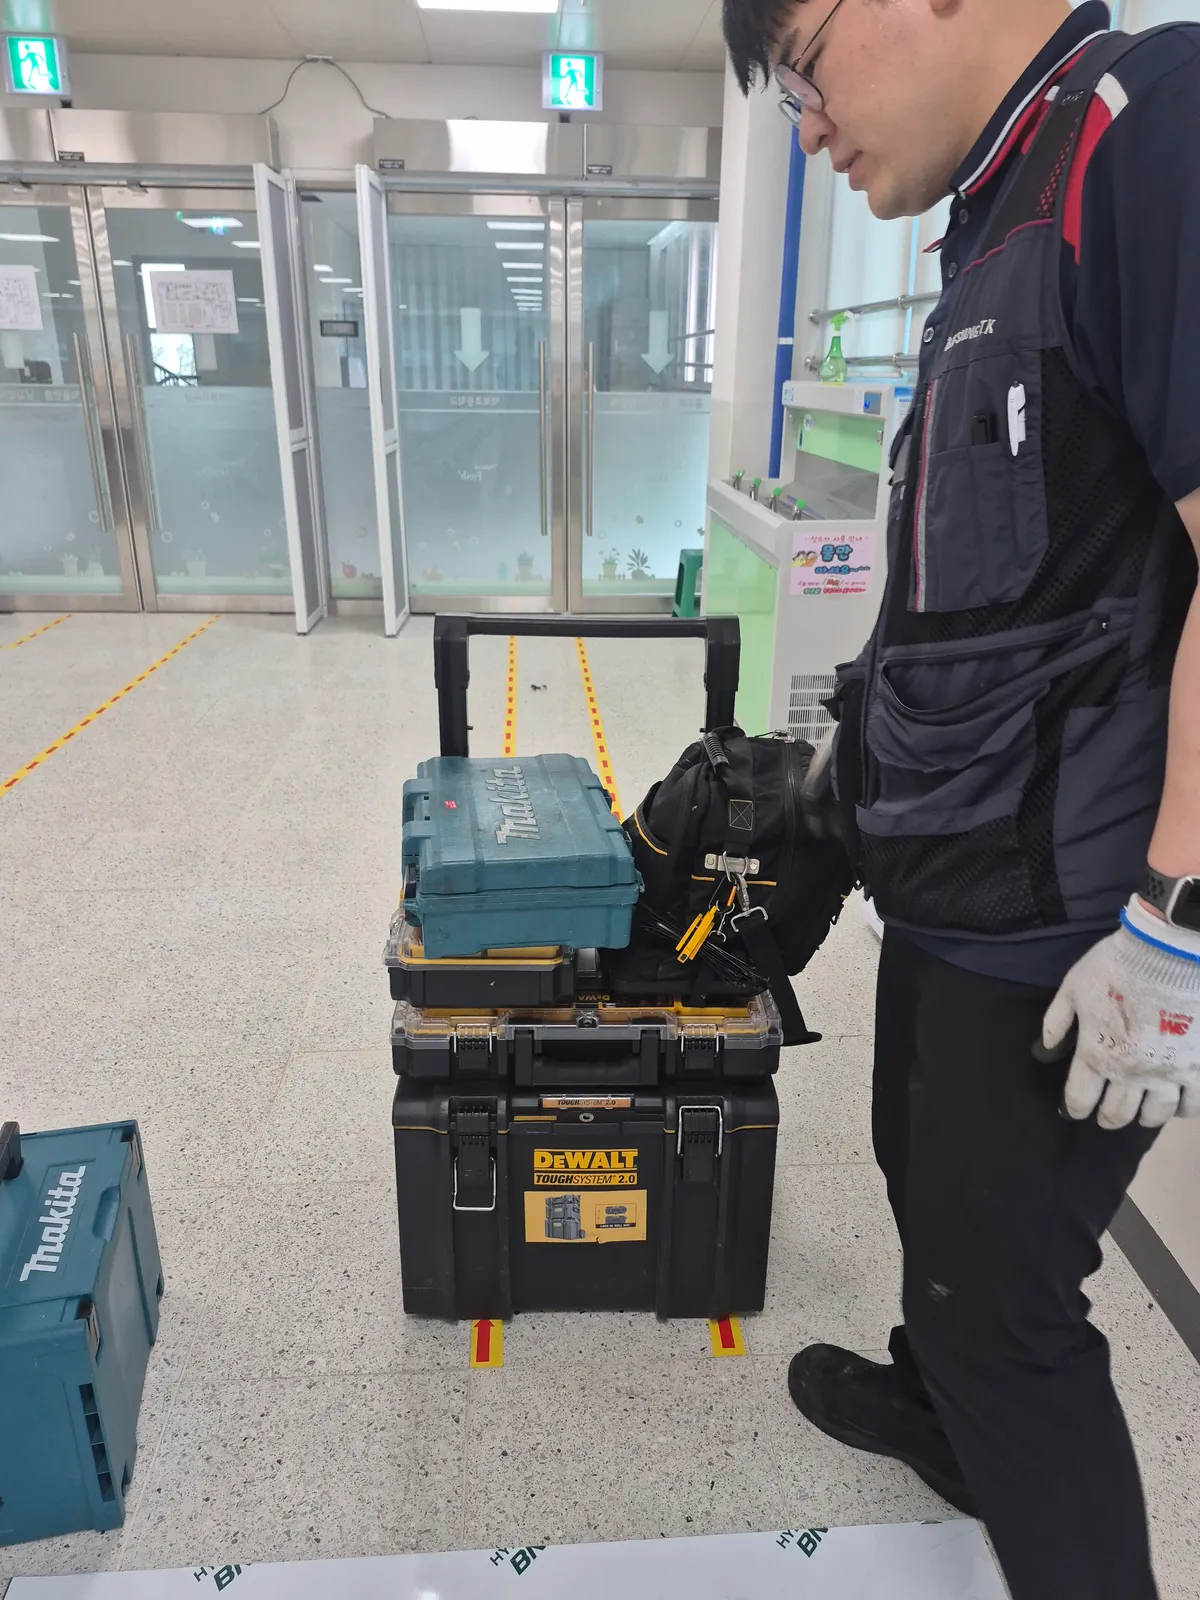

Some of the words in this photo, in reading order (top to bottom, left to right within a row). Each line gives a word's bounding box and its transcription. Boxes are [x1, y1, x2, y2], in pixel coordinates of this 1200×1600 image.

[820, 544, 854, 562] 물만
[618, 1174, 636, 1184] 2.0
[776, 1529, 797, 1550] HY
